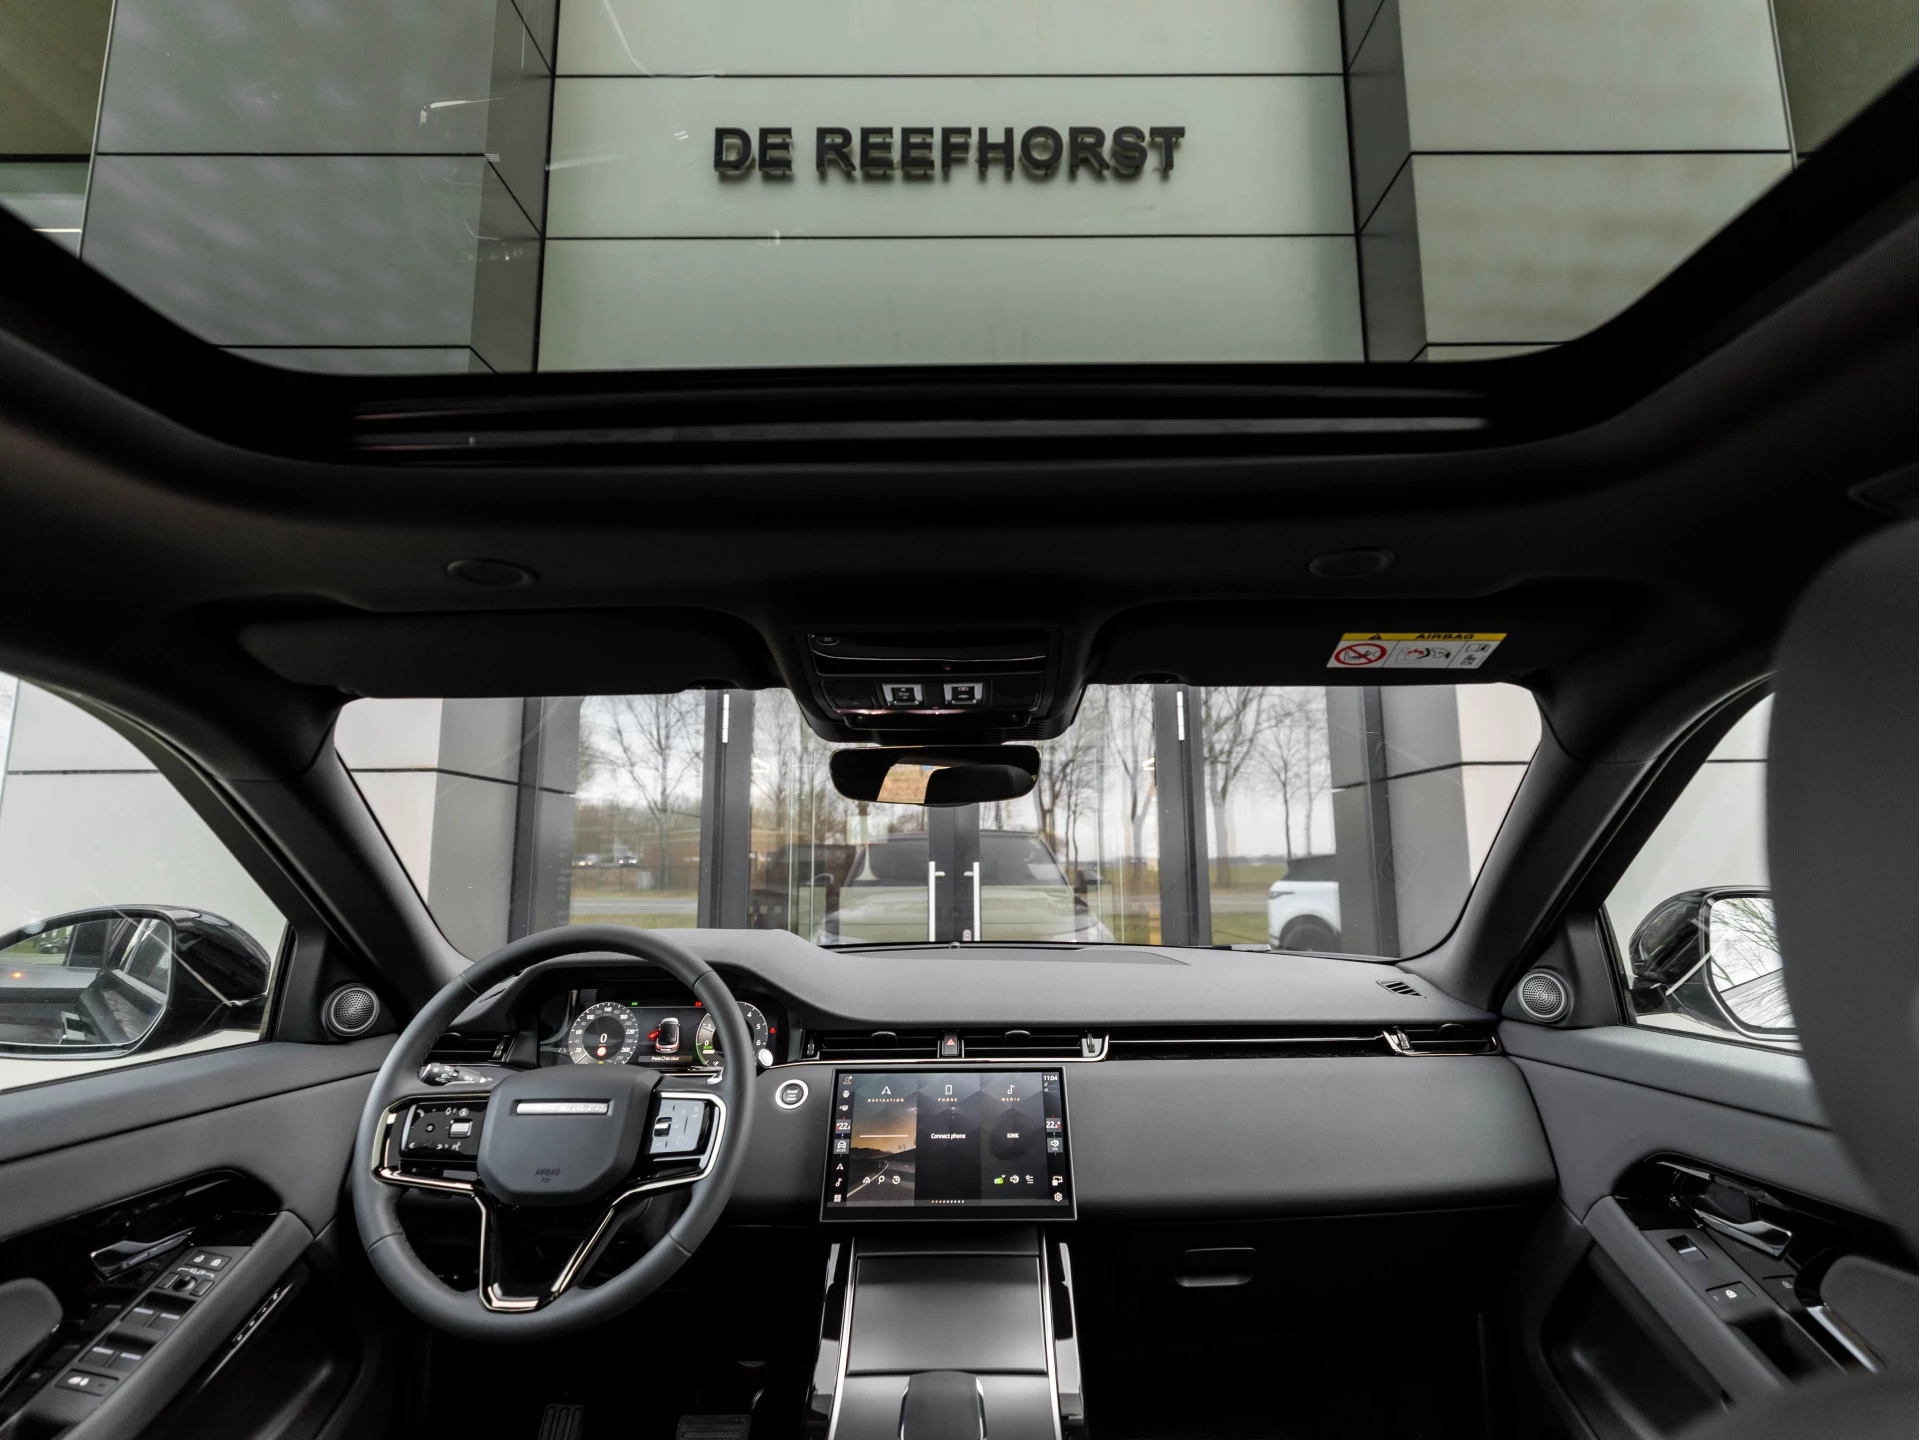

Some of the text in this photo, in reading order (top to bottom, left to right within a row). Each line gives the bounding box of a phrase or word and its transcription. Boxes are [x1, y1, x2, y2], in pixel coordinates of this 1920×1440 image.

[714, 126, 1186, 172] DE REEFHORST
[600, 1033, 608, 1043] 0
[950, 1132, 966, 1141] phone
[535, 1168, 561, 1176] AIRBAG
